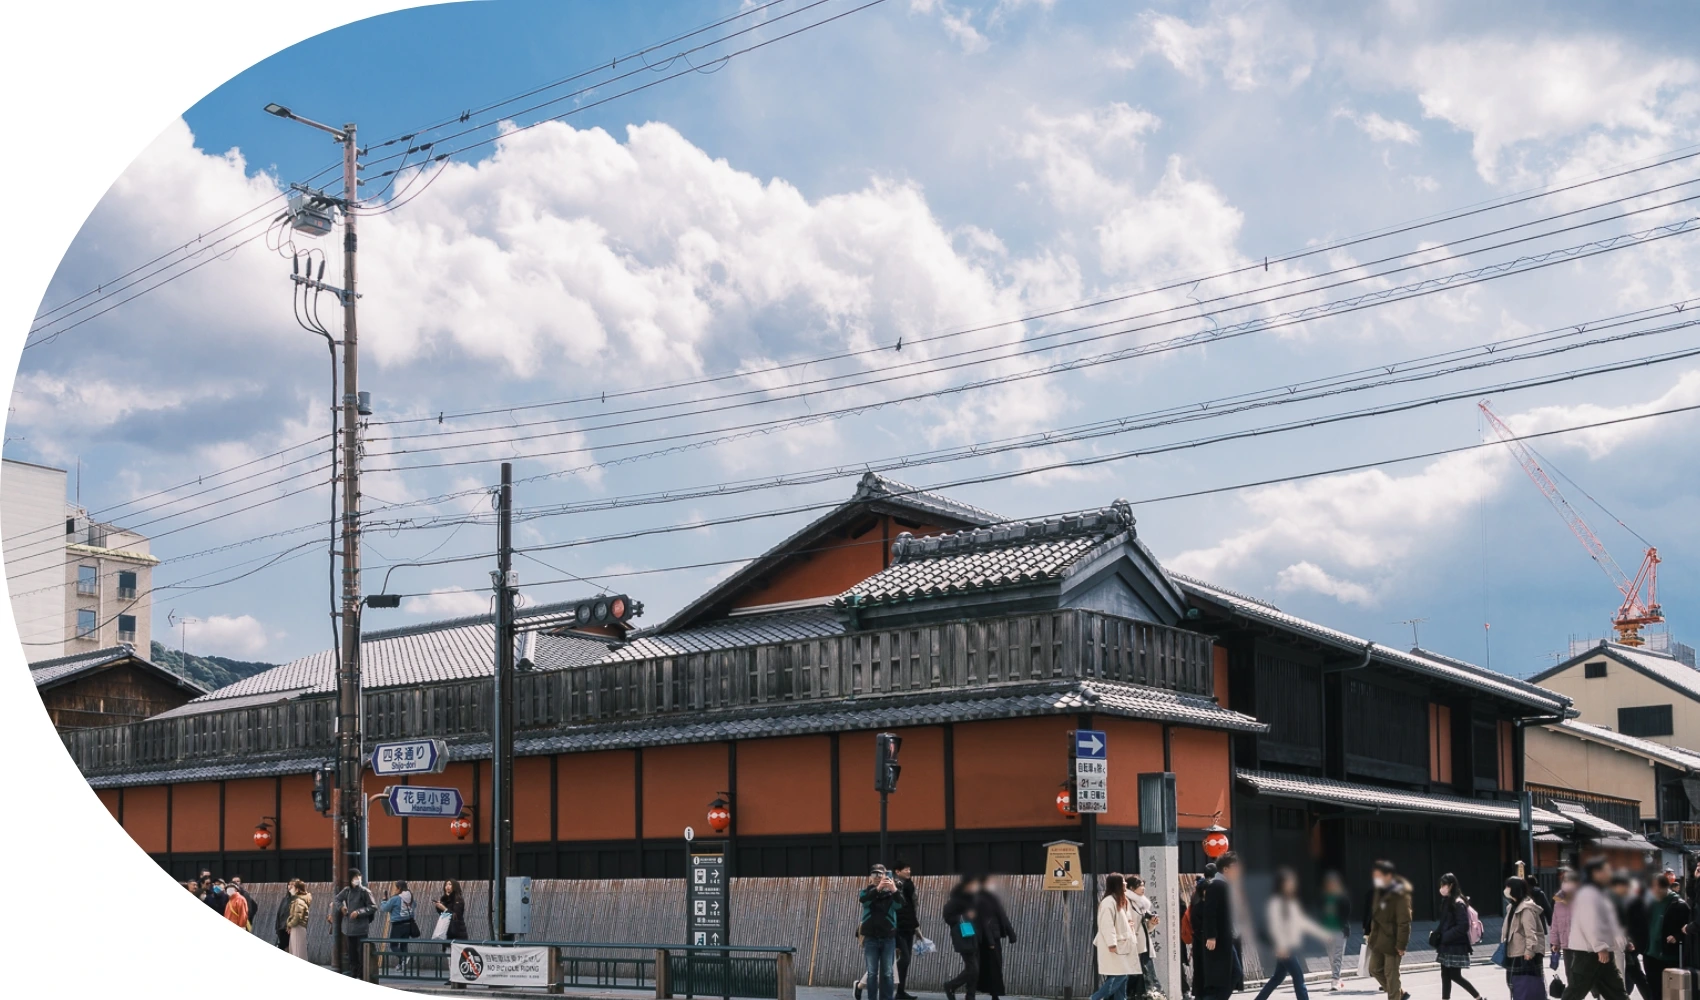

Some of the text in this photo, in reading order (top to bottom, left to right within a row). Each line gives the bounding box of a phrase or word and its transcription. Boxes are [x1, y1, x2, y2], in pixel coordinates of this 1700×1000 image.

[383, 746, 424, 762] 四条通り
[391, 761, 416, 771] Shijo-dori
[404, 791, 450, 805] 花見小路
[412, 805, 442, 814] Hanamikoji
